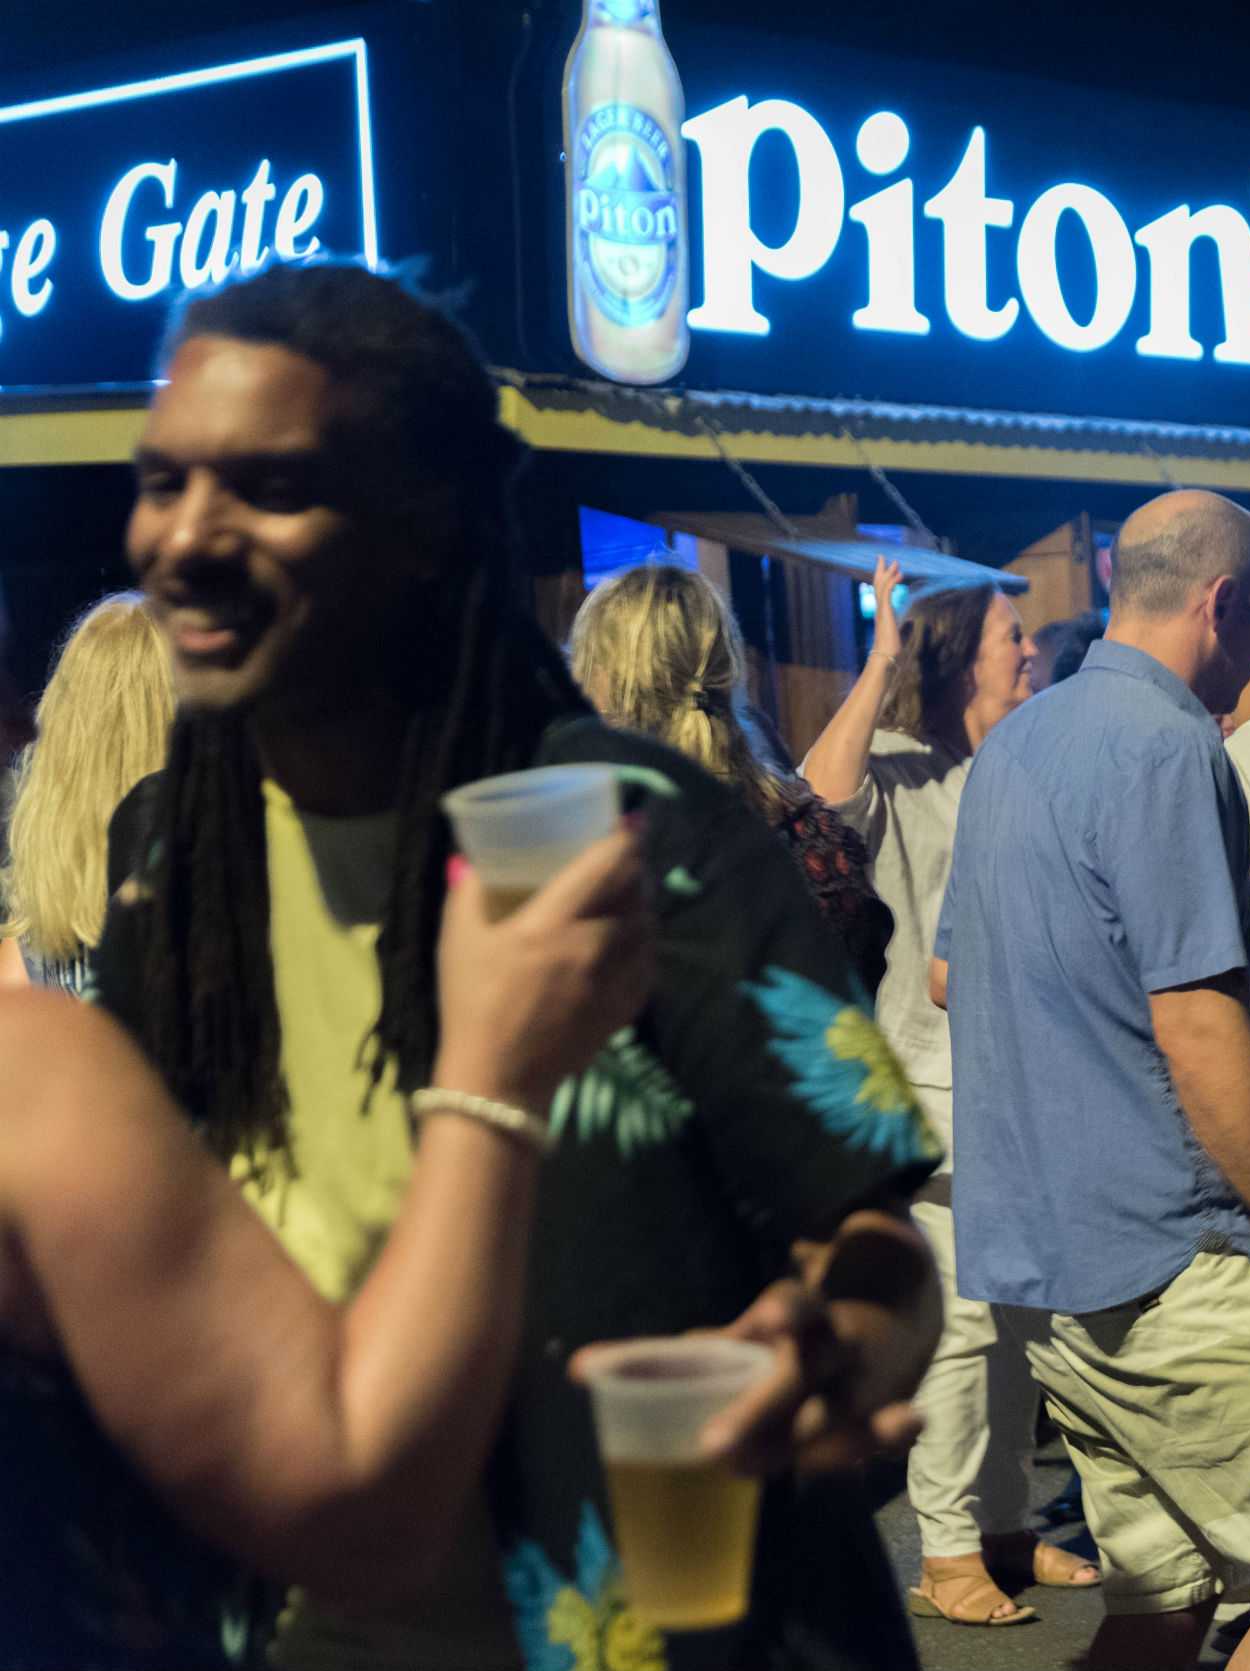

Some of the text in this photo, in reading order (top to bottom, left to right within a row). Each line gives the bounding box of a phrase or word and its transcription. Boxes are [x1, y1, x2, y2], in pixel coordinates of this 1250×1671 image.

[581, 108, 669, 158] LAGER BEER
[99, 157, 325, 300] Gate
[578, 189, 677, 236] Piton
